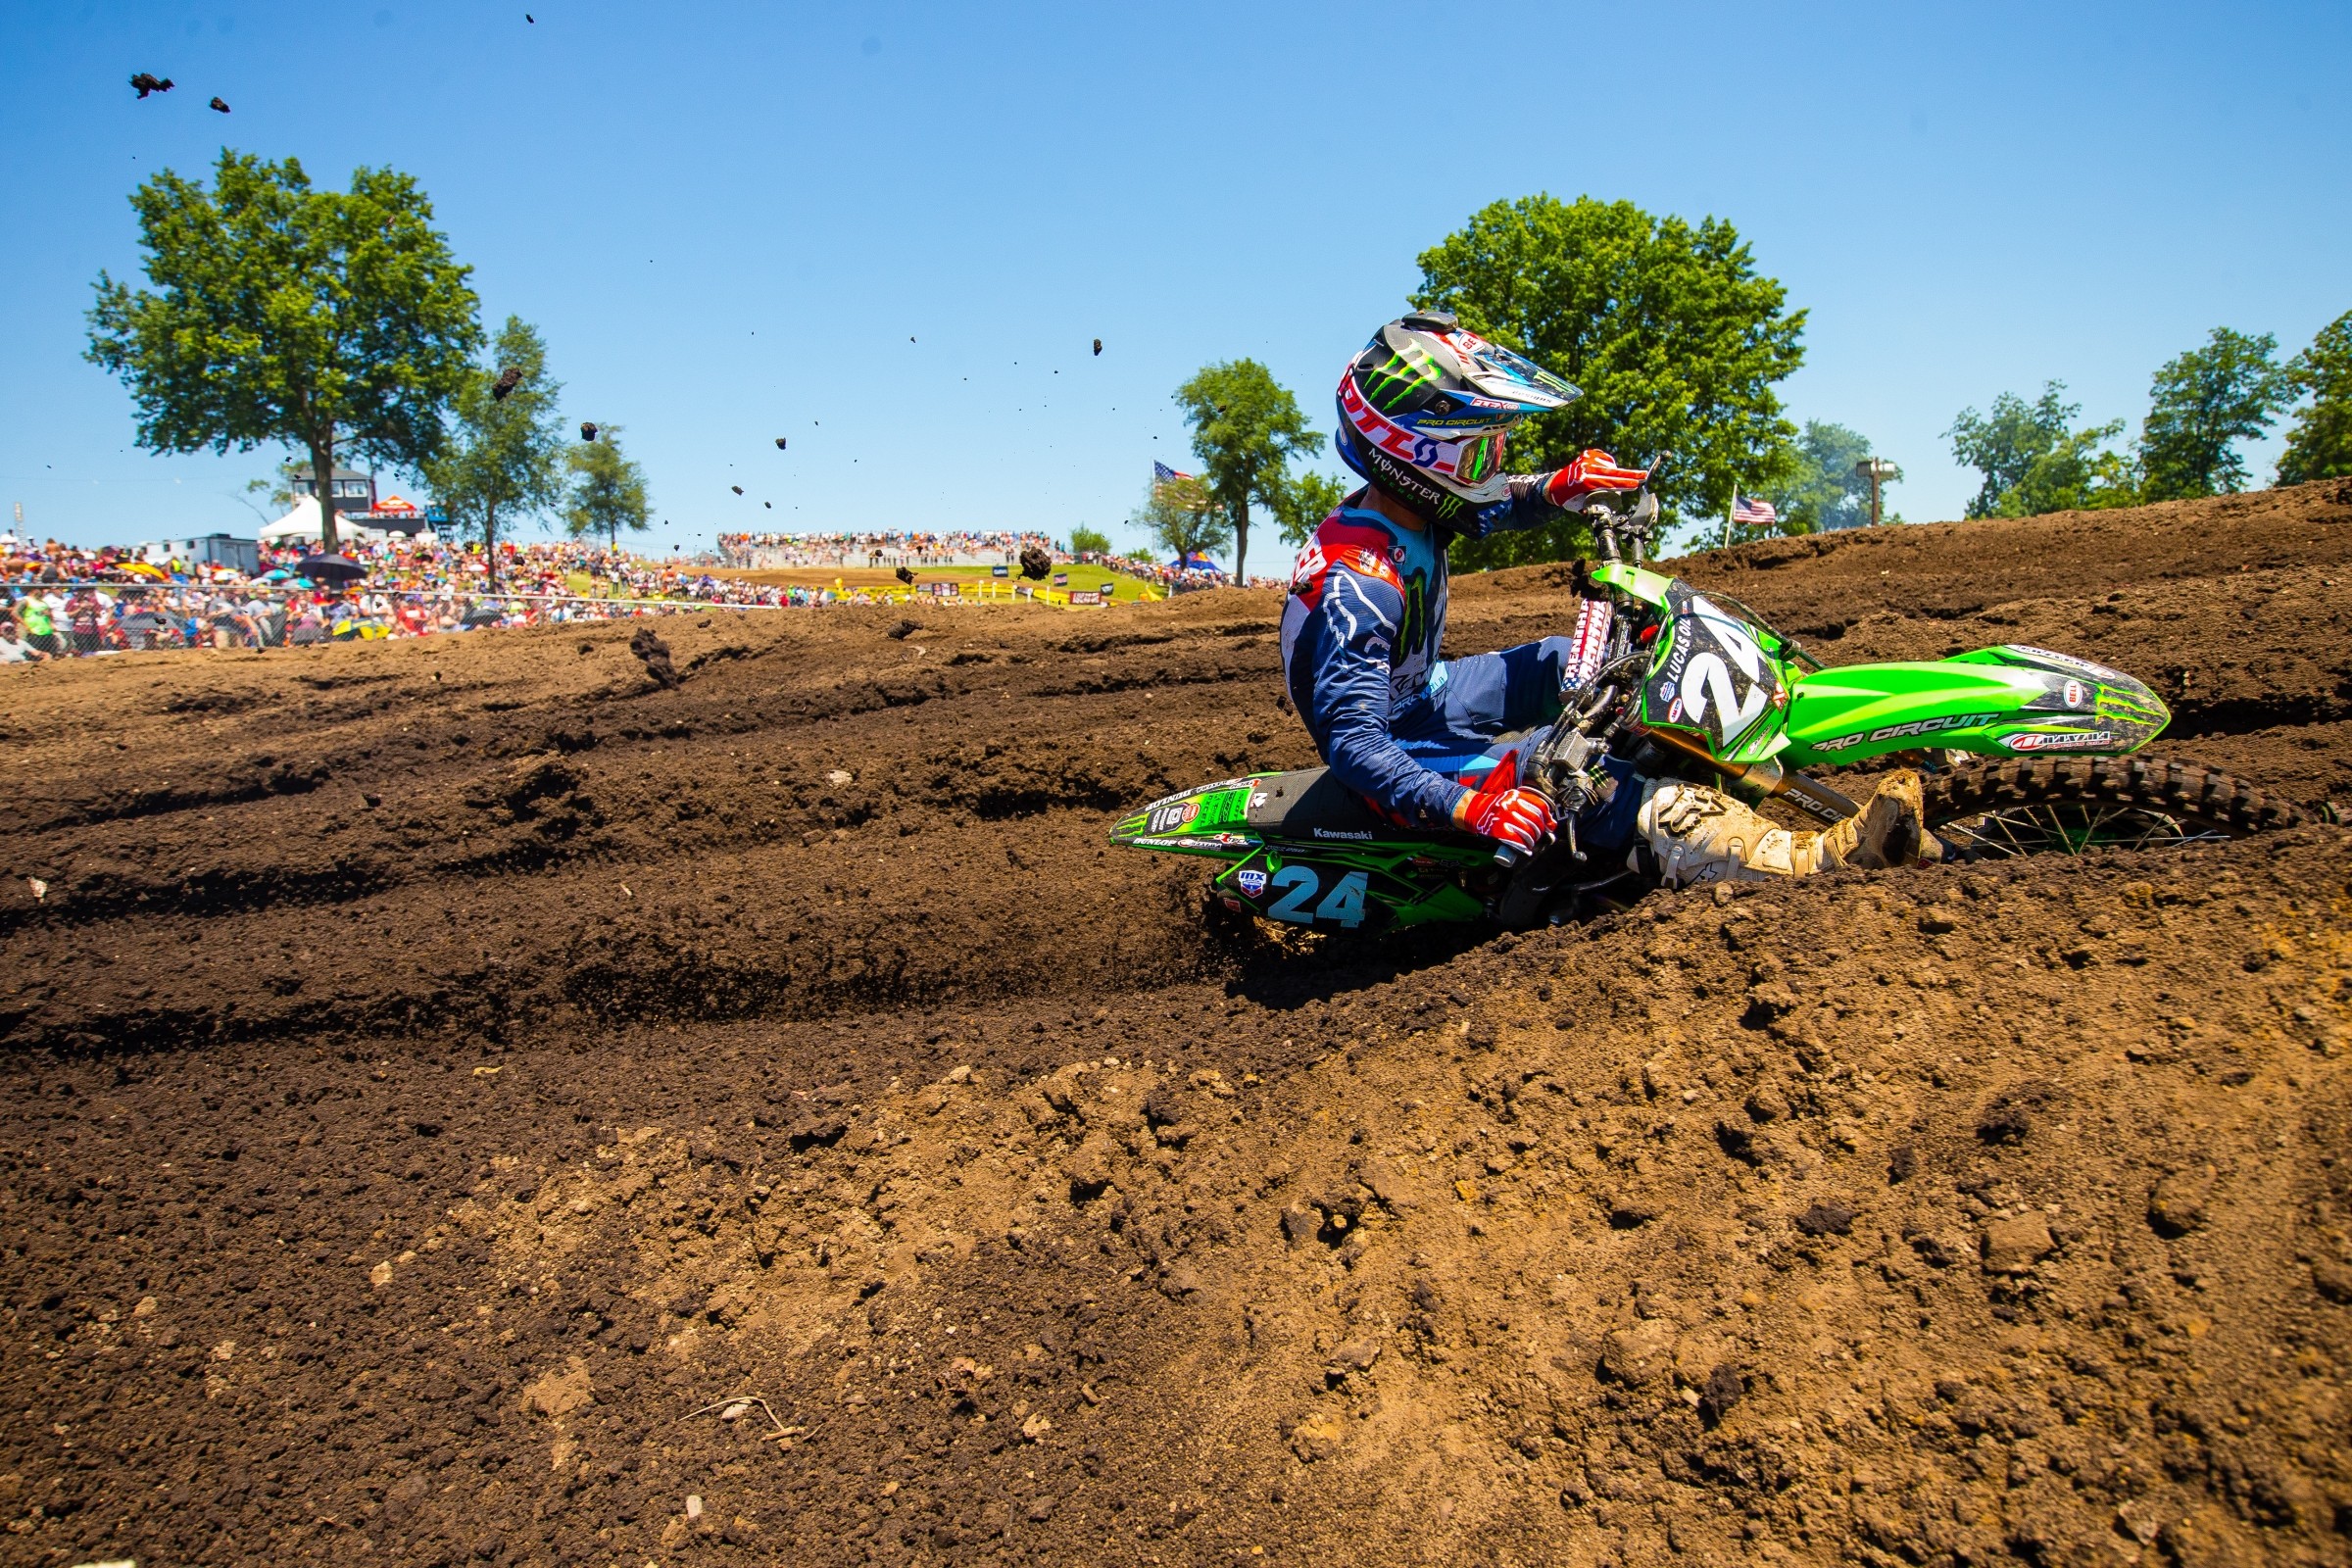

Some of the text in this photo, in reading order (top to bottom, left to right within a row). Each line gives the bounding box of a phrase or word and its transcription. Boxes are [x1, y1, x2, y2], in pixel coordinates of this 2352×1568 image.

[1446, 417, 1492, 426] CIRCUIT
[1369, 448, 1441, 505] MONSTER
[1563, 597, 1590, 679] RENTHA
[1578, 601, 1607, 683] RENTHA
[1678, 616, 1691, 637] OIL
[1667, 634, 1690, 683] LUCAS
[1681, 595, 1769, 748] 24
[1811, 713, 2000, 752] PRO CIRCUIT
[1145, 788, 1194, 811] DUNLOP
[1784, 788, 1823, 812] PRO
[1133, 837, 1177, 847] DUNLOP
[1313, 827, 1373, 840] Kawasaki
[1267, 865, 1369, 928] 24
